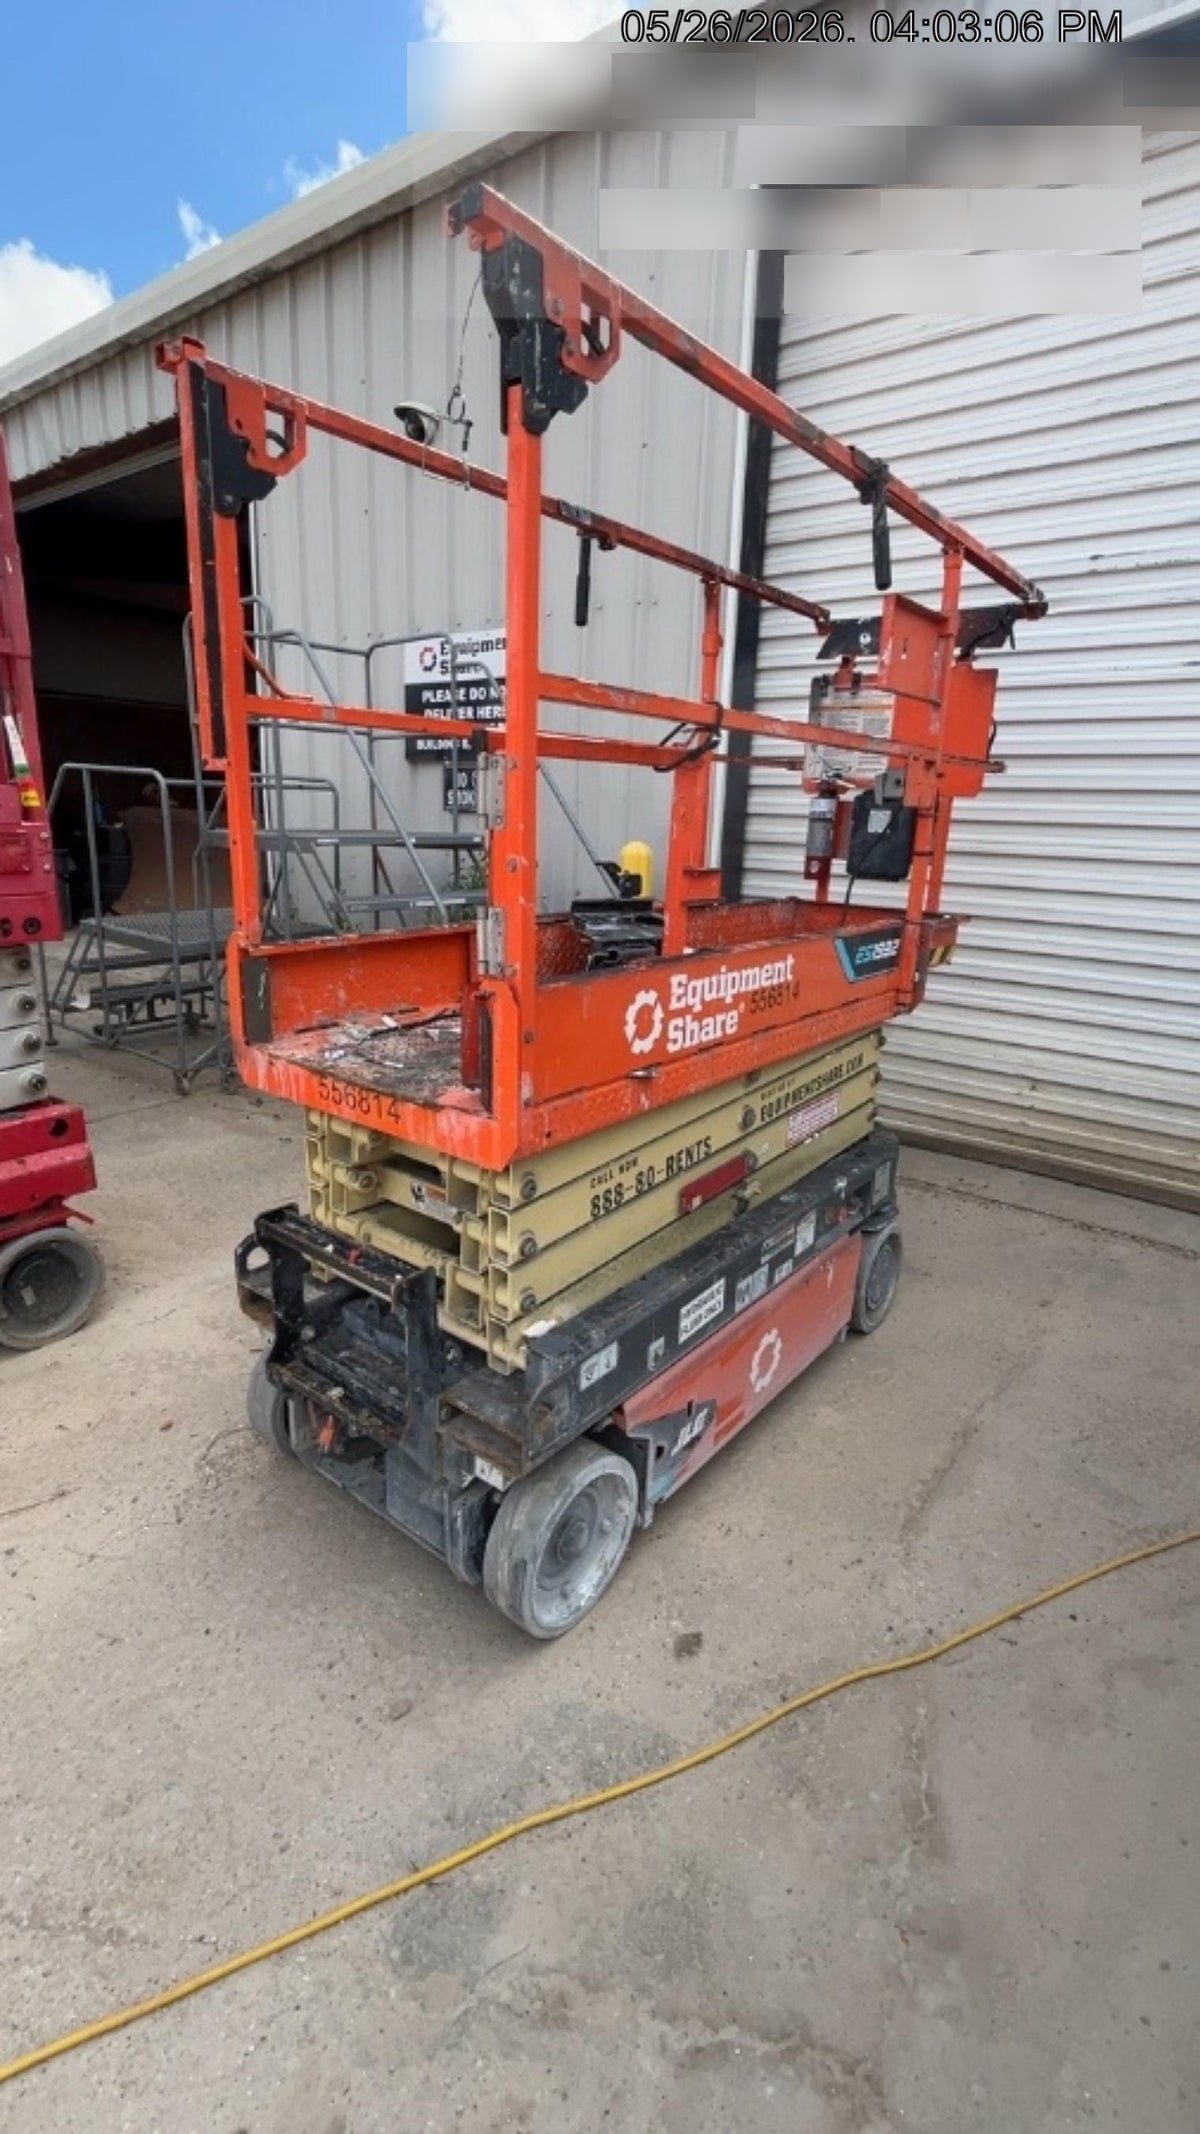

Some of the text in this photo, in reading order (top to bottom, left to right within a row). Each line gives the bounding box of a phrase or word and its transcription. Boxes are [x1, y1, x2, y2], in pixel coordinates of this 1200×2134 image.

[469, 687, 487, 701] DO
[669, 953, 795, 1013] Equipment
[749, 982, 801, 1015] 556814
[666, 1009, 739, 1053] Share
[318, 1077, 401, 1125] 556814
[590, 1156, 639, 1189] CALL NOW
[590, 1135, 712, 1219] 888-80-RENTS
